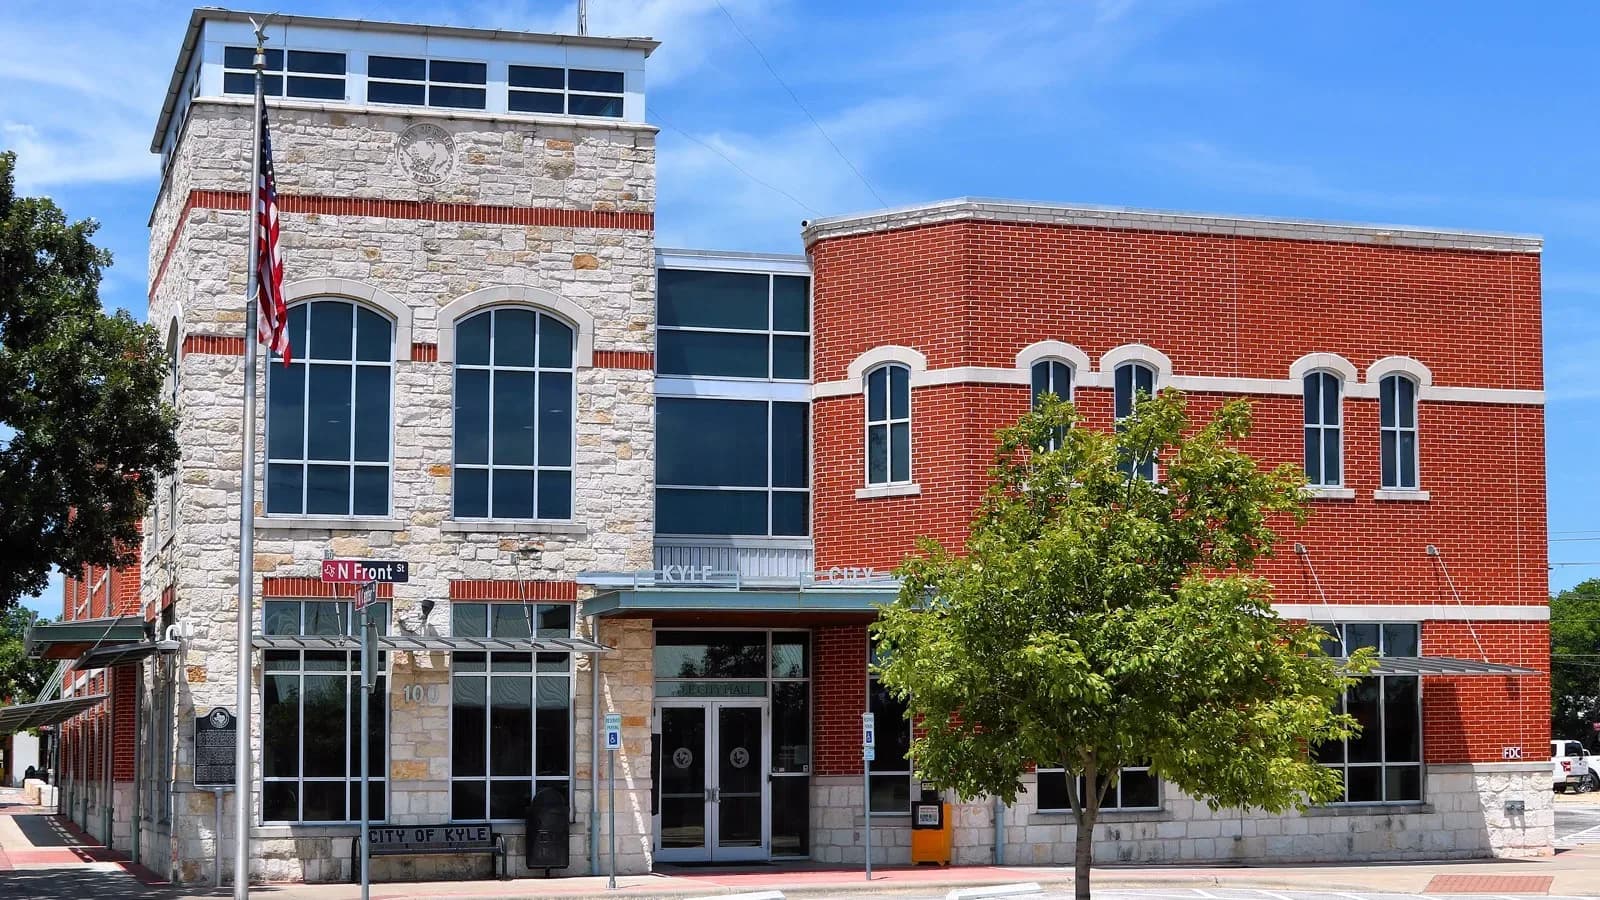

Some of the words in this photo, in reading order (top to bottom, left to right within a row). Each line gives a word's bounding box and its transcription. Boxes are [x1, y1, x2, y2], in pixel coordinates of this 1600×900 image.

[338, 563, 349, 580] N
[353, 562, 393, 580] Front
[396, 563, 405, 573] St
[829, 566, 874, 584] CITY
[403, 684, 440, 705] 100
[725, 684, 753, 695] HALL
[1504, 747, 1521, 759] FDC
[368, 830, 405, 843] CITY
[415, 829, 435, 842] OF
[444, 828, 488, 842] KYLE
